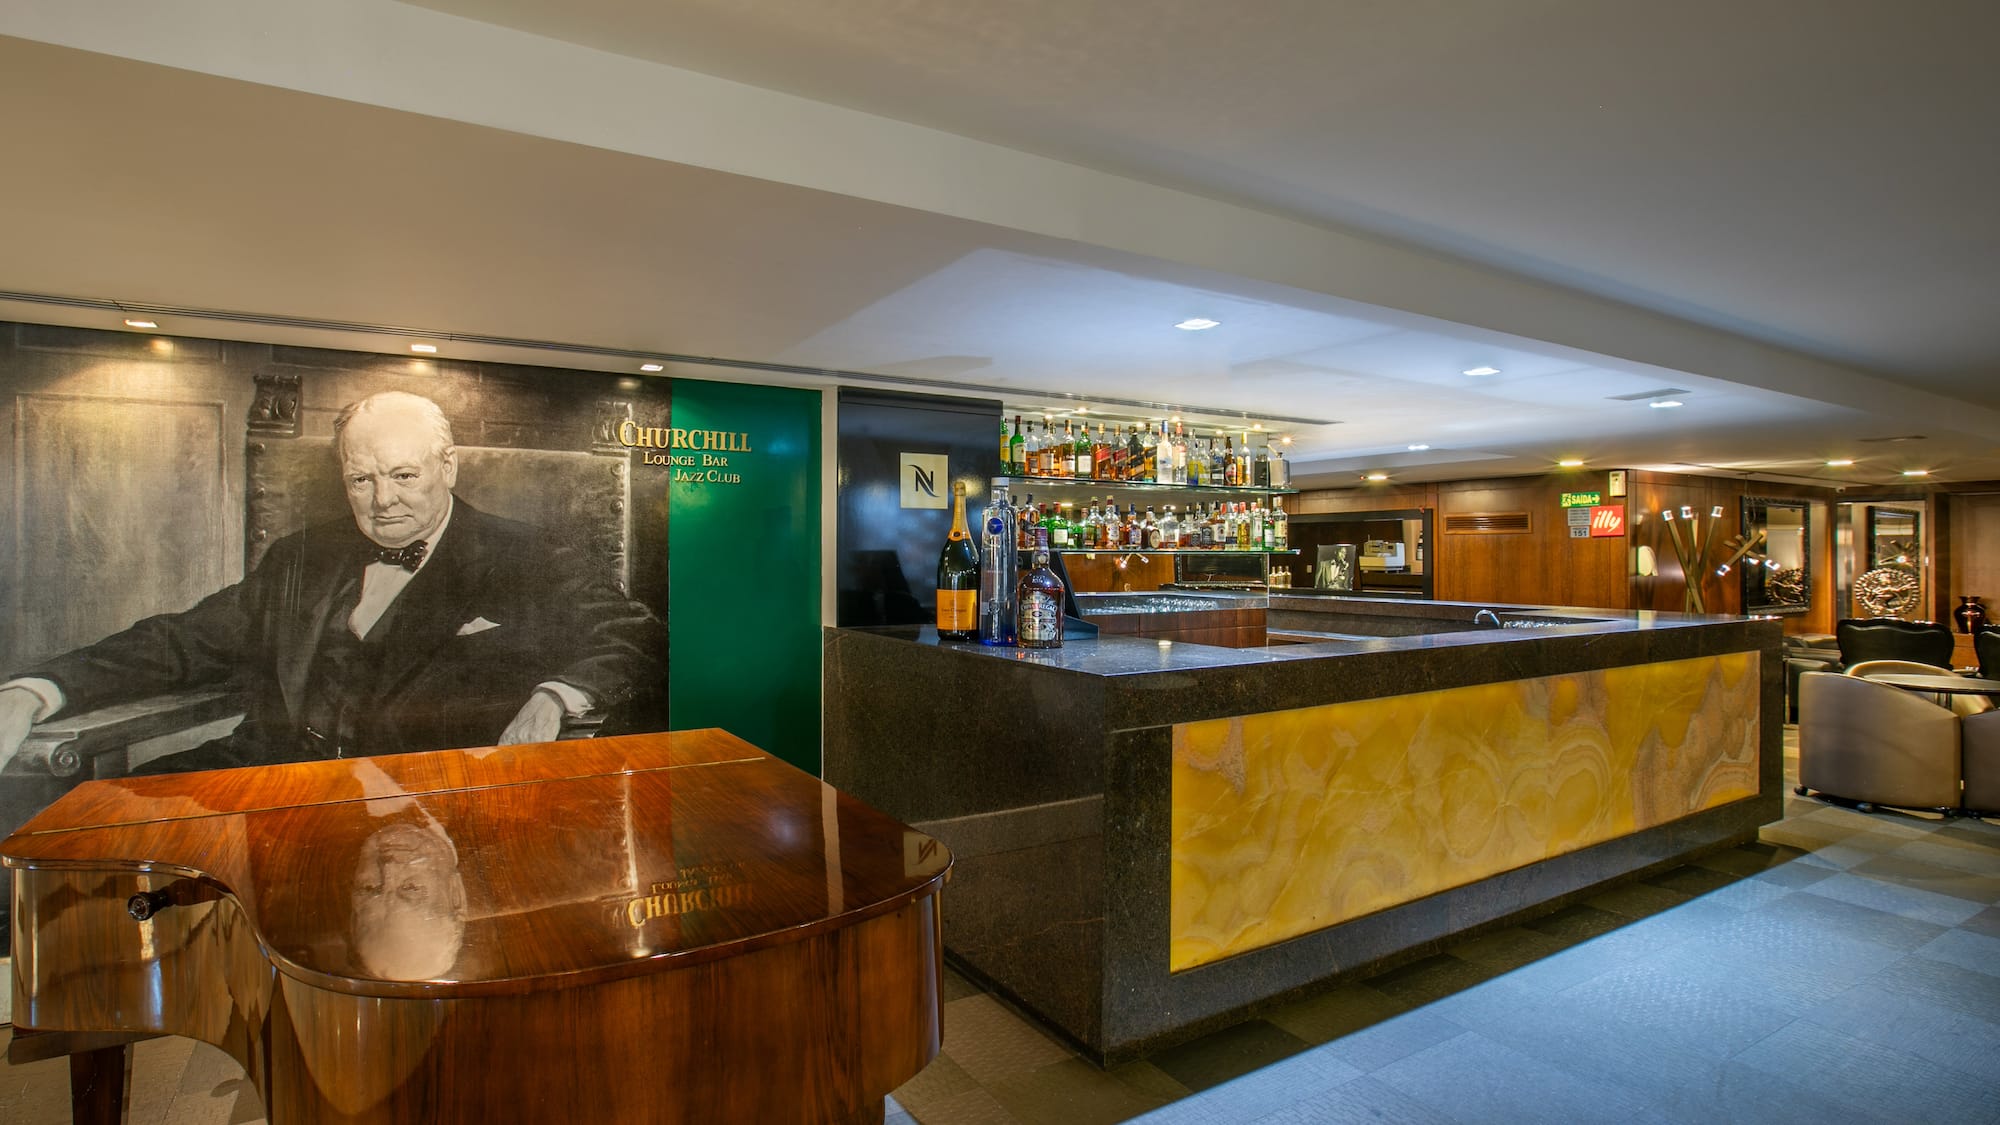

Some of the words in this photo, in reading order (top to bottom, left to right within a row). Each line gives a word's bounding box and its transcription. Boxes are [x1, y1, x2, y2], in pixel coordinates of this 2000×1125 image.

[619, 420, 752, 452] CHURCHILL
[644, 452, 695, 467] LOUNGE
[702, 454, 729, 468] BAR
[674, 468, 705, 483] JAZZ
[706, 470, 741, 485] CLUB
[1593, 510, 1621, 532] illy
